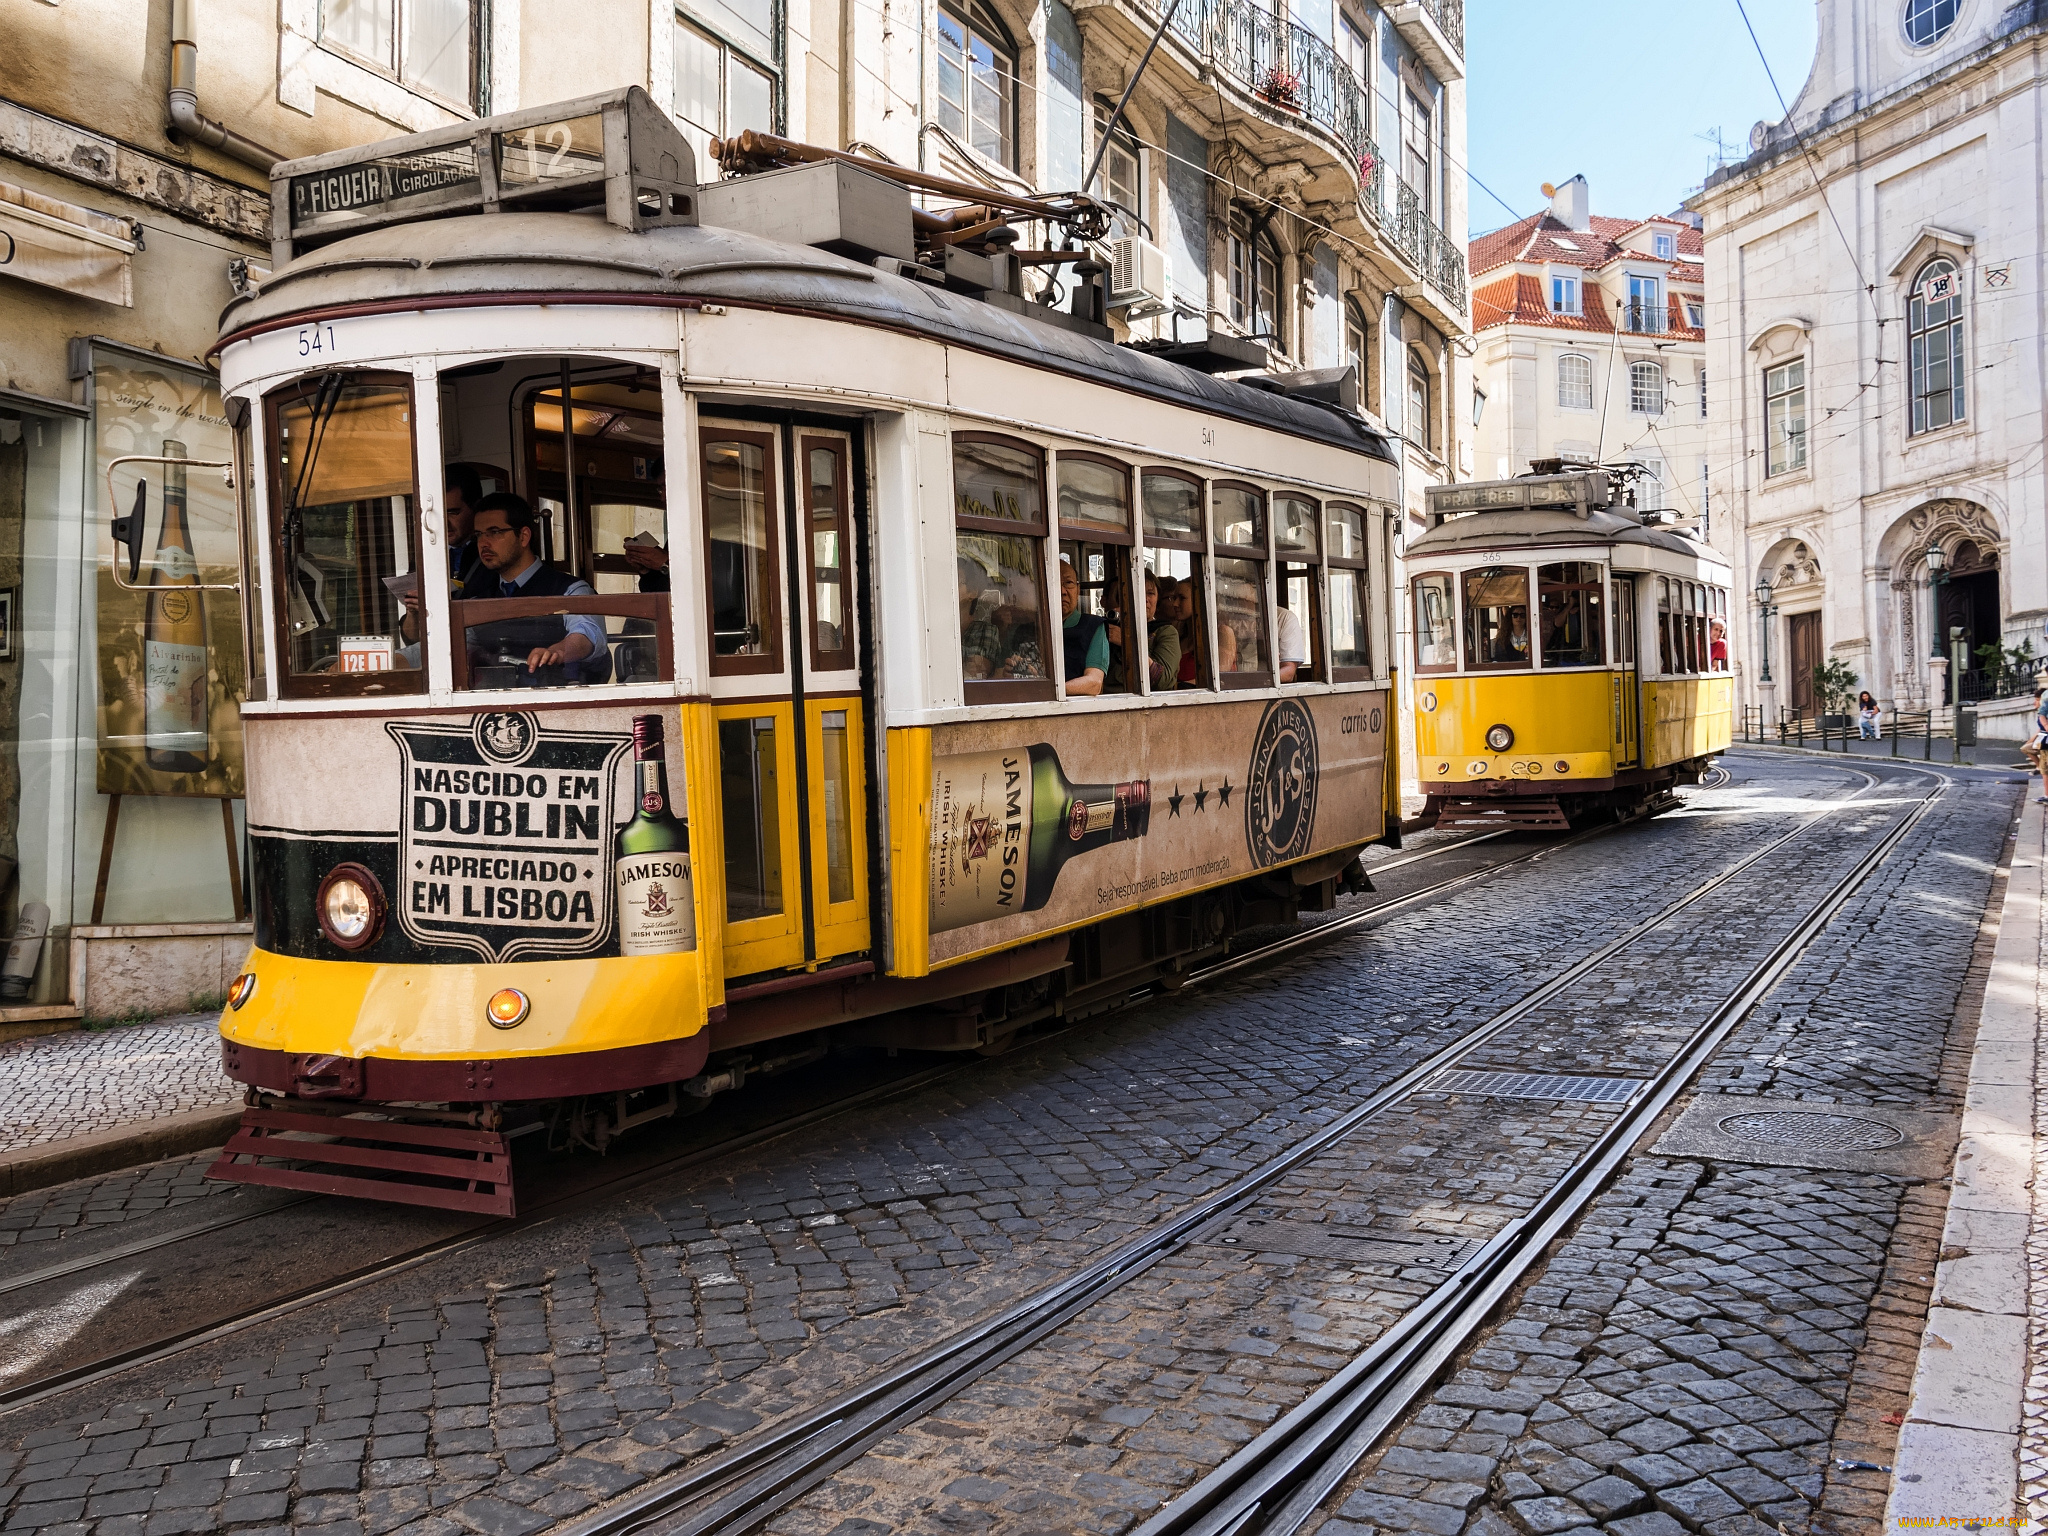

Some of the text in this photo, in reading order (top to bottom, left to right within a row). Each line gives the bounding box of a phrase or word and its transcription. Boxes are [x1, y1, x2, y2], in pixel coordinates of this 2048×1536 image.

[521, 123, 575, 178] 12
[295, 165, 394, 217] P. FIGUEIRA
[1933, 278, 1948, 291] 18
[299, 326, 335, 356] 541
[116, 393, 155, 413] single
[157, 402, 173, 414] in
[175, 404, 195, 418] the
[1202, 427, 1215, 447] 541
[1482, 552, 1501, 562] 565
[151, 645, 201, 662] Alvarinho
[343, 653, 365, 672] 12E
[1341, 707, 1367, 734] carris
[1253, 710, 1311, 811] JOHN JAMESON
[413, 767, 600, 800] NASCIDO EM
[412, 795, 600, 840] DUBLIN
[996, 757, 1022, 907] JAMESON
[939, 780, 951, 908] IRISH WHISKEY
[429, 853, 578, 883] APRECIADO
[620, 862, 691, 886] JAMESON
[1097, 855, 1232, 906] Seja responsável. Beba com moderação.
[412, 881, 595, 923] EM LISBOA
[653, 928, 687, 936] WHISKEY
